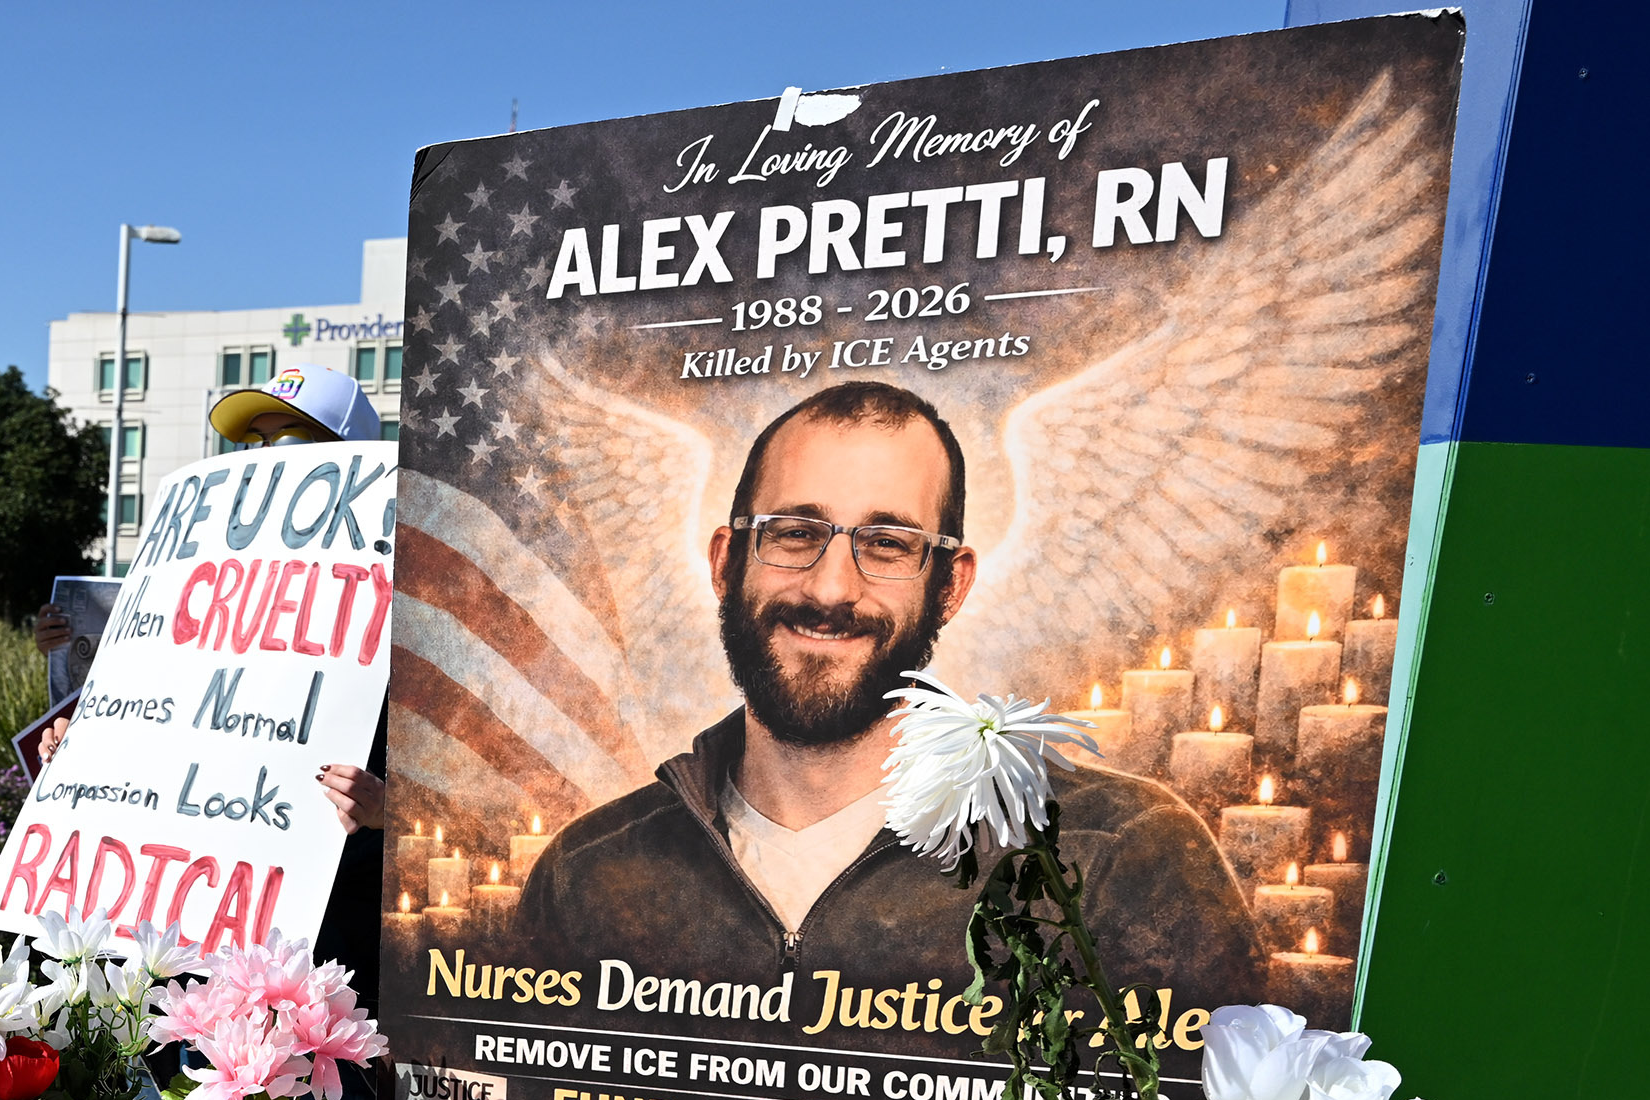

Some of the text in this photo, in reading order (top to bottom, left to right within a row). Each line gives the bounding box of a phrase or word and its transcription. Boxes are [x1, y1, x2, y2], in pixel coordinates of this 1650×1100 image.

[664, 99, 1100, 194] In Loving Memory of
[545, 157, 1229, 301] ALEX PRETTI, RN
[730, 294, 824, 333] 1988
[862, 283, 972, 322] 2026
[679, 330, 1032, 380] Killed by ICE Agents
[225, 461, 285, 551] U
[104, 576, 164, 649] When
[172, 558, 394, 666] CRUELTY
[68, 667, 325, 746] Becomes Normal
[33, 737, 293, 832] Compassion Looks
[425, 948, 583, 1007] Nurses
[595, 958, 792, 1022] Demand
[801, 969, 1003, 1037] Justice
[474, 1034, 611, 1074] REMOVE
[621, 1047, 681, 1081] ICE
[687, 1054, 786, 1090] FROM
[797, 1064, 871, 1097] OUR
